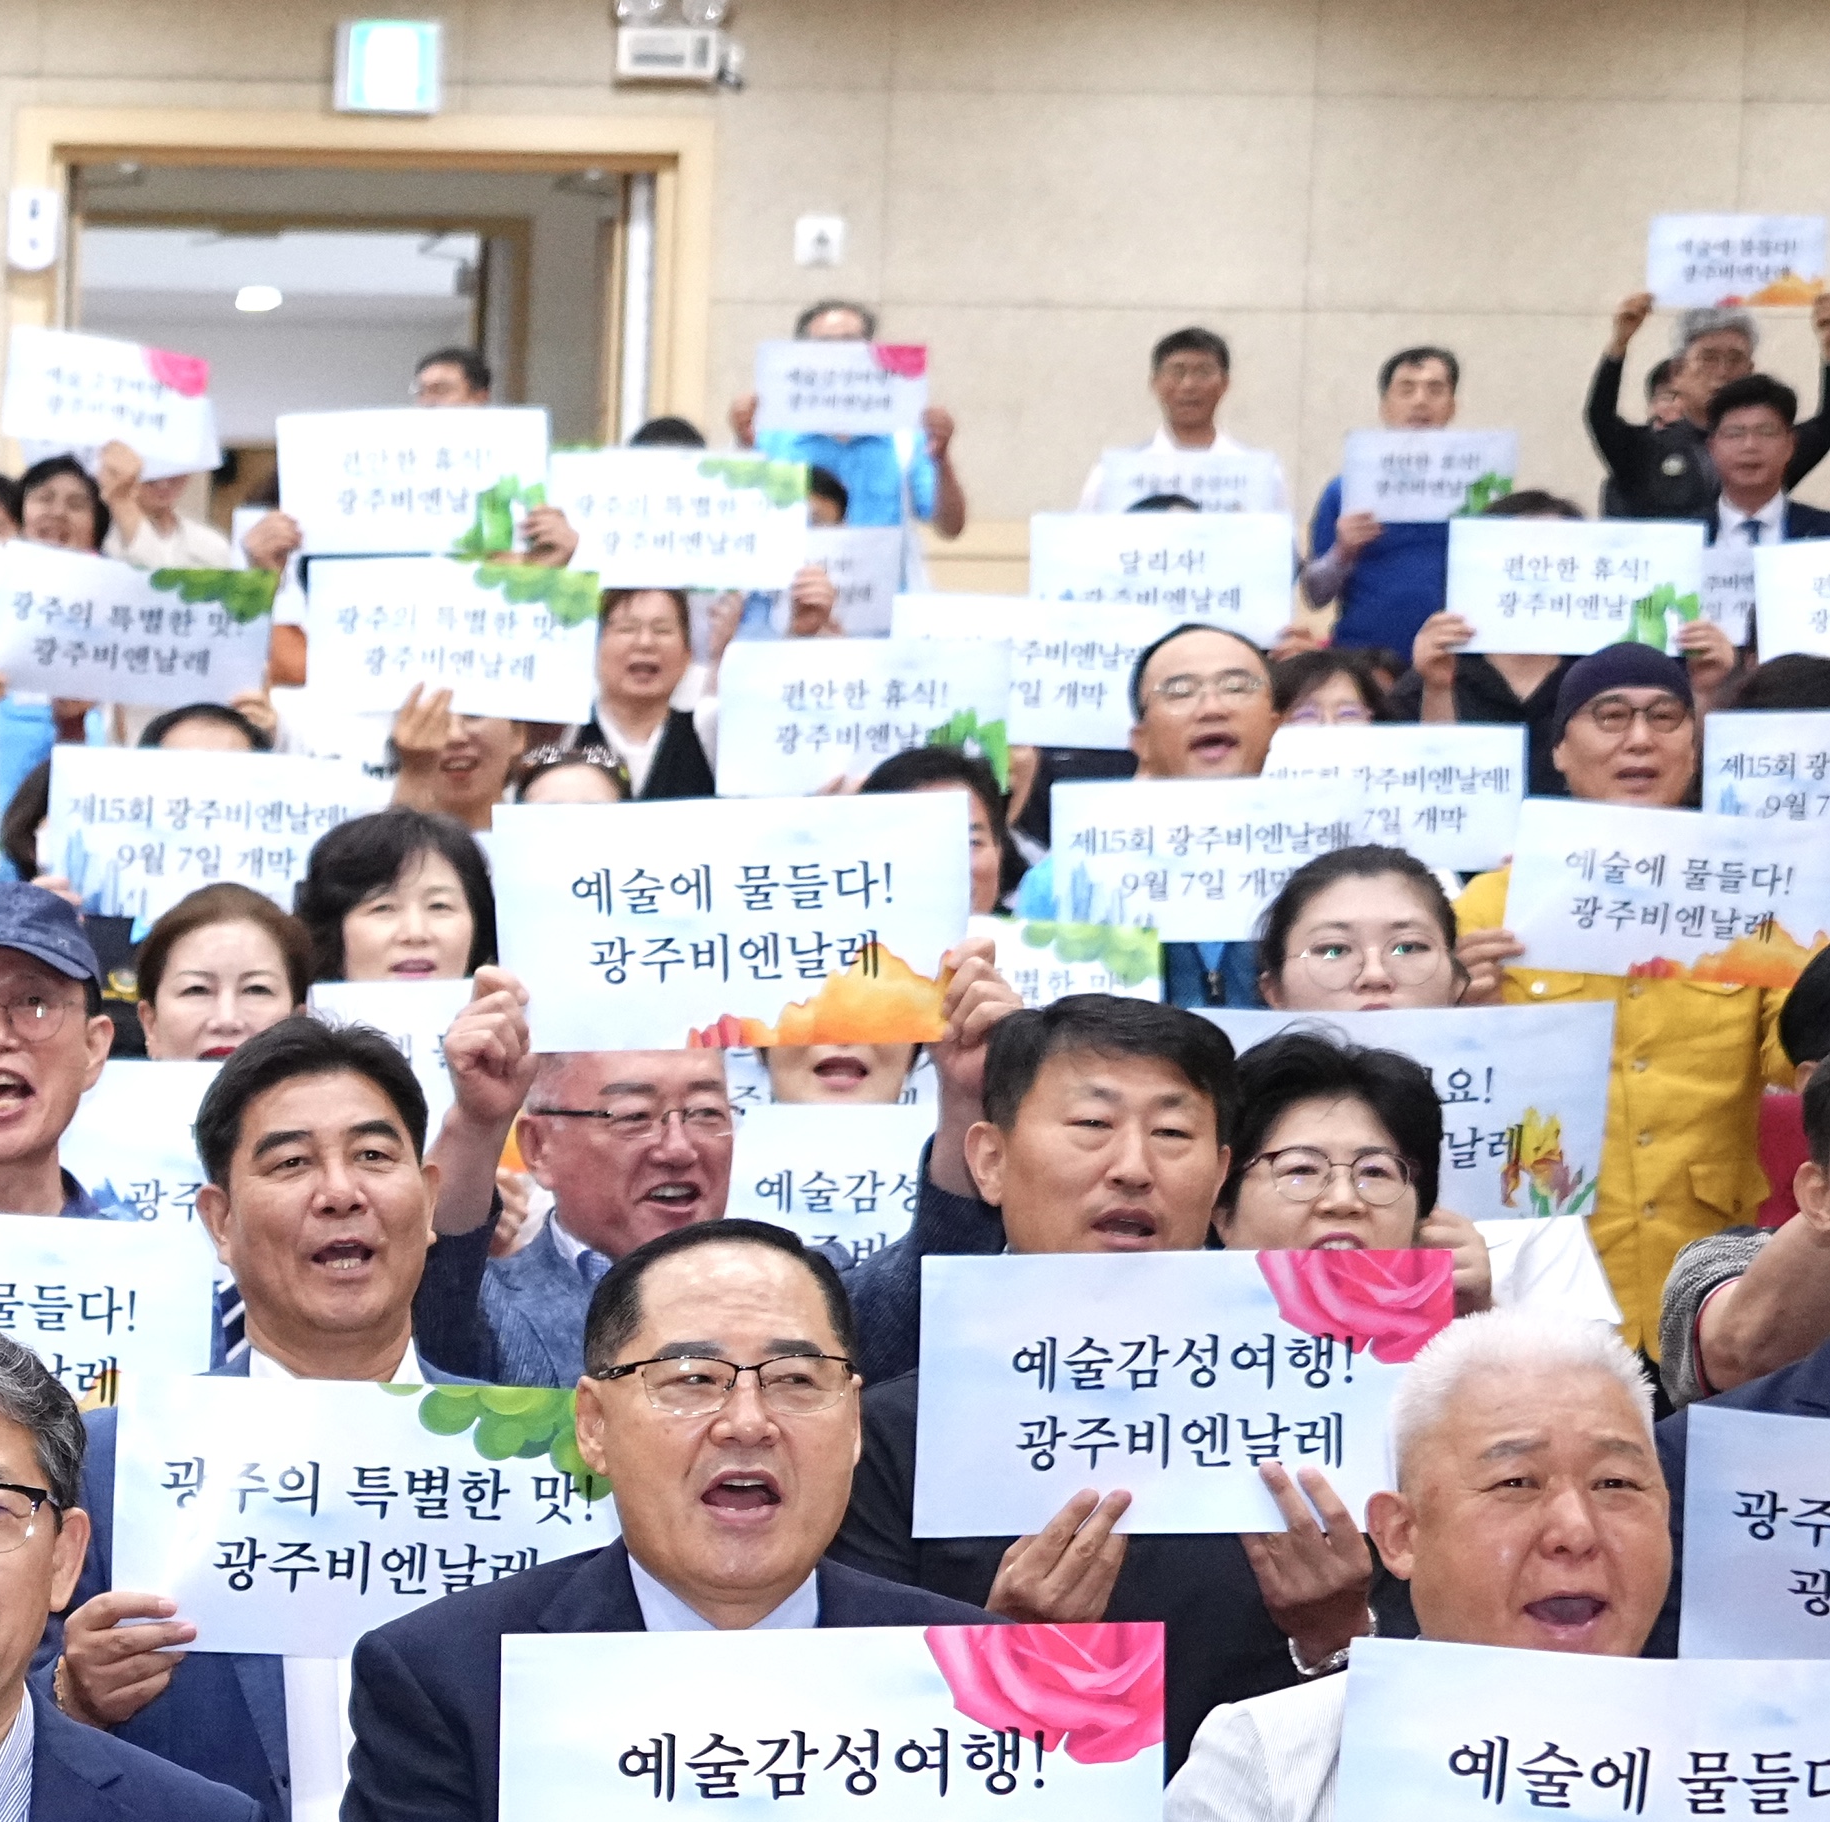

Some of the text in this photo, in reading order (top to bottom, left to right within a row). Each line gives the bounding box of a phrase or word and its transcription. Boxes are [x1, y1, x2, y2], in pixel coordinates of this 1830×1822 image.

[1118, 548, 1206, 575] 달리자!
[1501, 555, 1651, 584] 편안한 휴식!
[11, 591, 95, 630] 광주의
[110, 598, 199, 635] 특별한
[209, 608, 245, 640] 맛!
[1082, 587, 1243, 614] 광주비엔날레
[1496, 589, 1654, 622] 광주비엔날레
[336, 603, 572, 642] 광주의 특별한 맛!
[33, 635, 212, 677] 광주비엔날레
[364, 644, 538, 681] 광주비엔날레
[780, 680, 950, 711] 편안한 휴식!
[1054, 680, 1107, 712] 개막
[774, 722, 952, 755] 광주비엔날레
[1721, 752, 1796, 783] 제15회
[69, 798, 154, 831] 제15회
[1363, 806, 1466, 834] 7일 개막
[1764, 793, 1806, 820] 9월
[1069, 817, 1350, 855] 제15회 광주비엔날레!
[117, 844, 297, 881] 9월 7일 개막
[1565, 848, 1794, 897] 예술에 물들다!
[571, 860, 894, 914] 예술에 물들다!
[1121, 870, 1170, 901] 9월
[1180, 868, 1226, 900] 7일
[1569, 894, 1775, 945] 광주비엔날레
[589, 928, 881, 985] 광주비엔날레
[1012, 1334, 1355, 1394] 예술감성여행!
[1015, 1410, 1344, 1474] 광주비엔날레
[160, 1455, 595, 1526] 광주의 특별한 맛!
[213, 1536, 541, 1598] 광주비엔날레
[616, 1724, 1048, 1803] 예술감성여행!
[1448, 1734, 1651, 1816] 예술에
